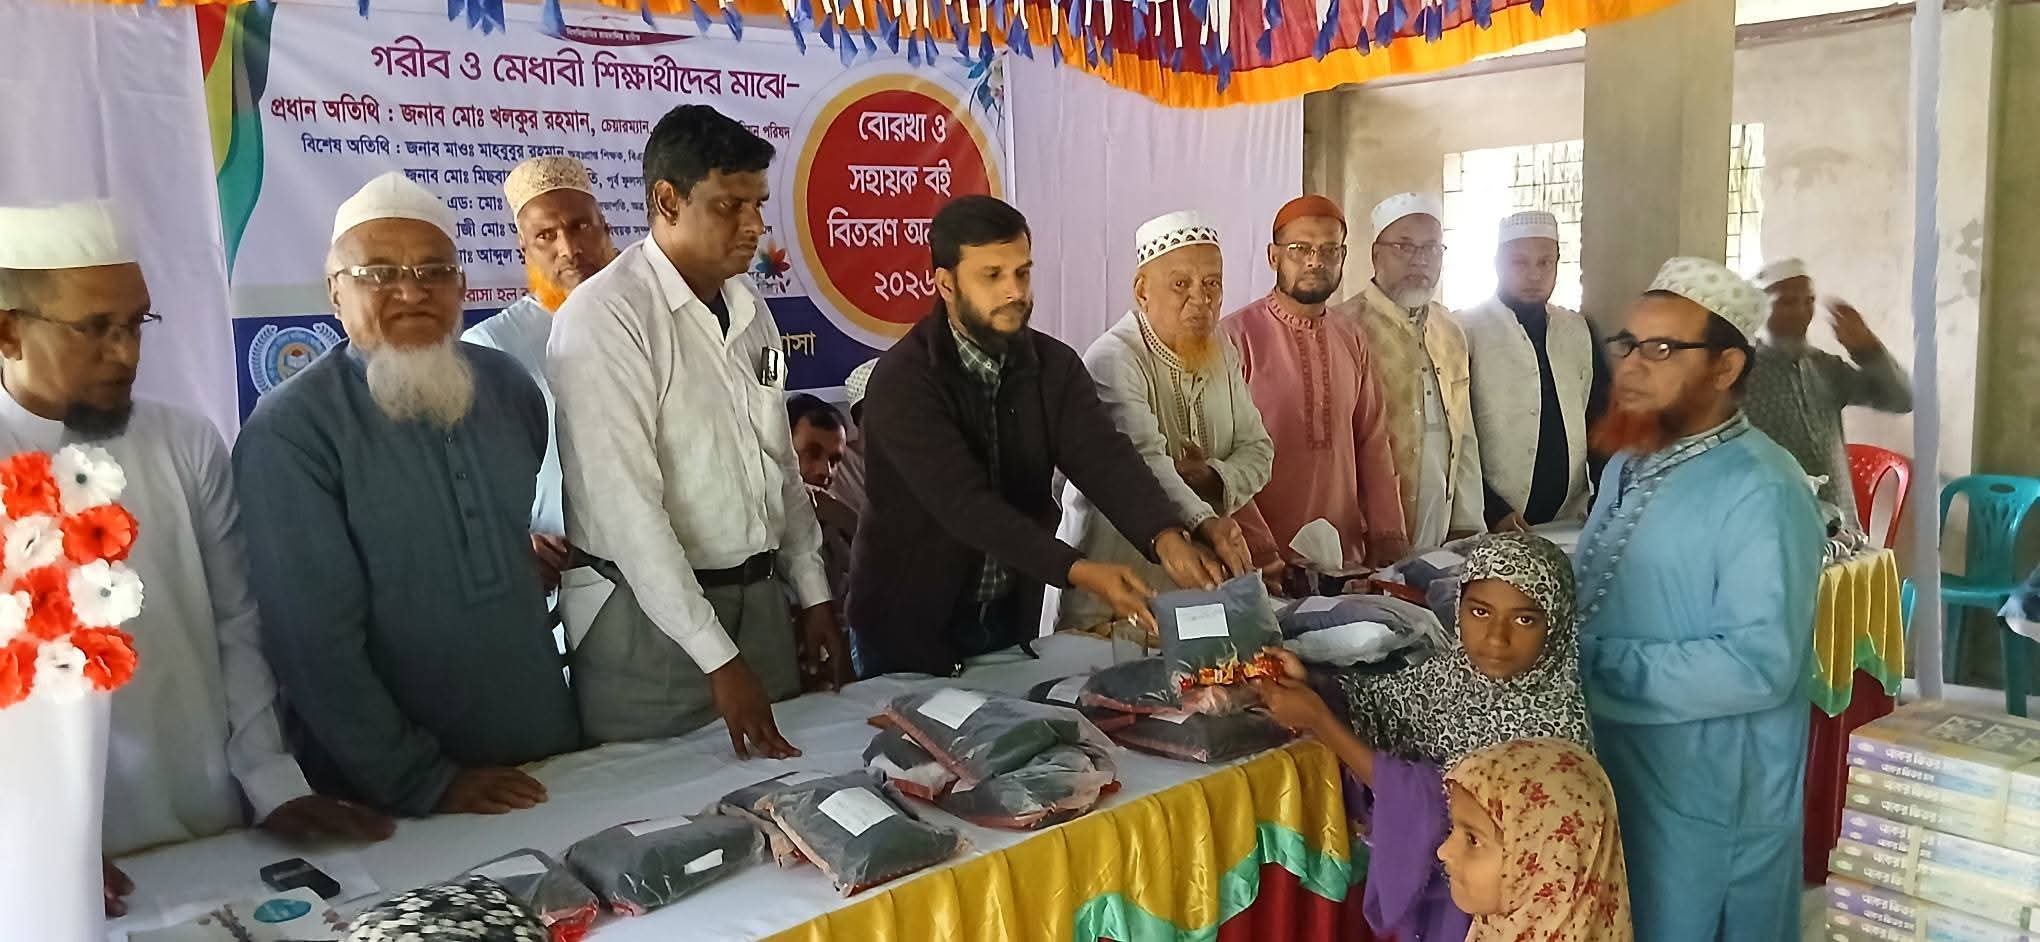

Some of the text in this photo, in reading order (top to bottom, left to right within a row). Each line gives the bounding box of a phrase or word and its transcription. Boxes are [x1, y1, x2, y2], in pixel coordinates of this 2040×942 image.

[371, 35, 451, 80] গরীব
[459, 52, 482, 81] ও
[493, 48, 584, 88] মেধাবী
[592, 50, 722, 96] শিক্ষার্থীদের
[271, 97, 316, 122] প্রধান
[322, 93, 381, 124] অতিথি
[399, 102, 446, 127] জনাব
[452, 105, 485, 128] মোঃ
[542, 110, 596, 137] রহমান,
[859, 111, 948, 143] বোরখা ও
[301, 132, 342, 154] বিশেষ
[346, 134, 390, 155] অতিথি
[405, 140, 440, 157] জনাব
[444, 141, 475, 158] মাওঃ
[478, 142, 525, 163] মাহবুবুর
[445, 169, 469, 185] মোঃ
[848, 158, 952, 197] সহায়ক বই
[477, 196, 503, 211] মোঃ
[481, 222, 505, 237] মোঃ
[827, 206, 898, 247] বিতরণ
[874, 269, 936, 301] ২০২৬
